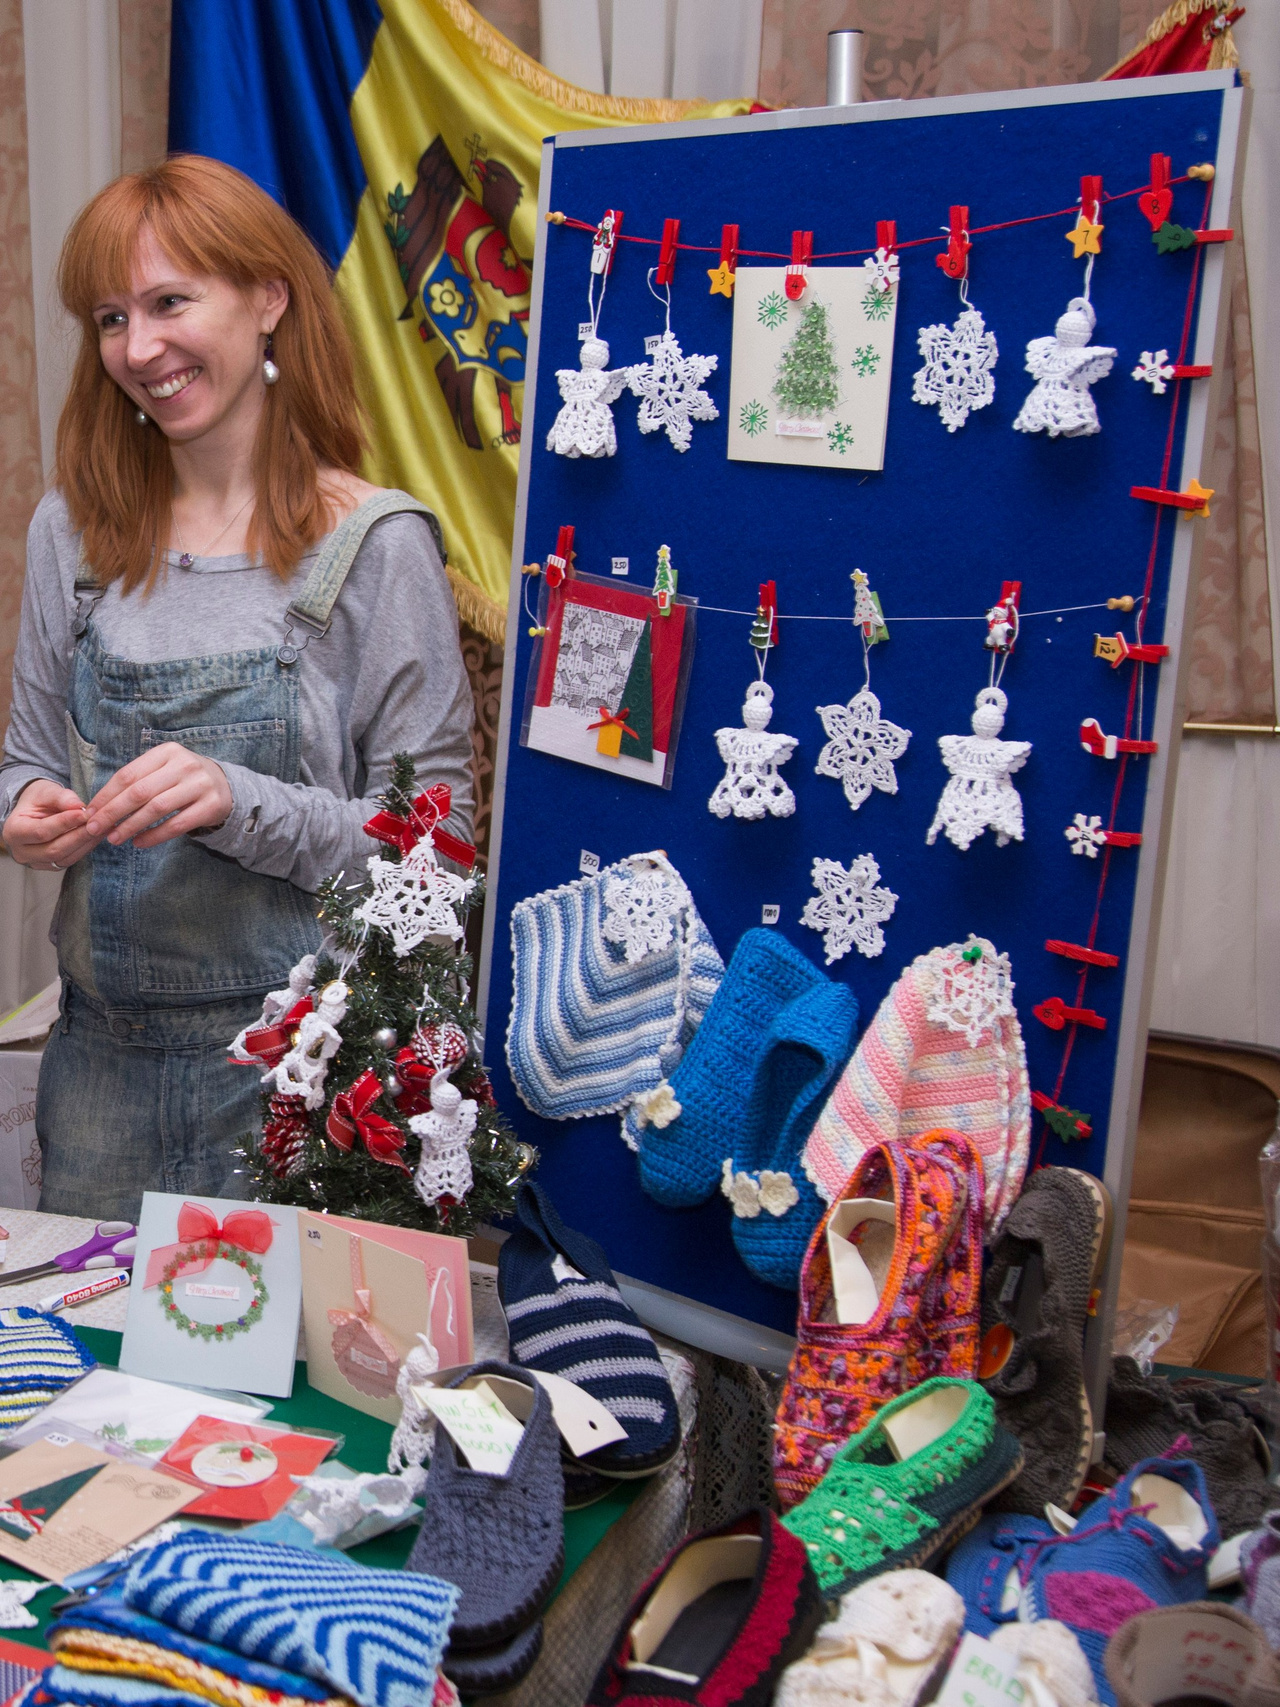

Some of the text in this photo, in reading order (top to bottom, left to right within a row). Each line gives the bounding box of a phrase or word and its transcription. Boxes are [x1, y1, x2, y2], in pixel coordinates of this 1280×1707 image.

[1152, 200, 1161, 214] 8
[1082, 230, 1091, 245] 7
[876, 265, 885, 277] 5
[949, 258, 957, 271] 6
[719, 271, 726, 285] 3
[791, 280, 800, 291] 4
[582, 854, 599, 867] 500
[67, 1279, 118, 1302] edding 8040
